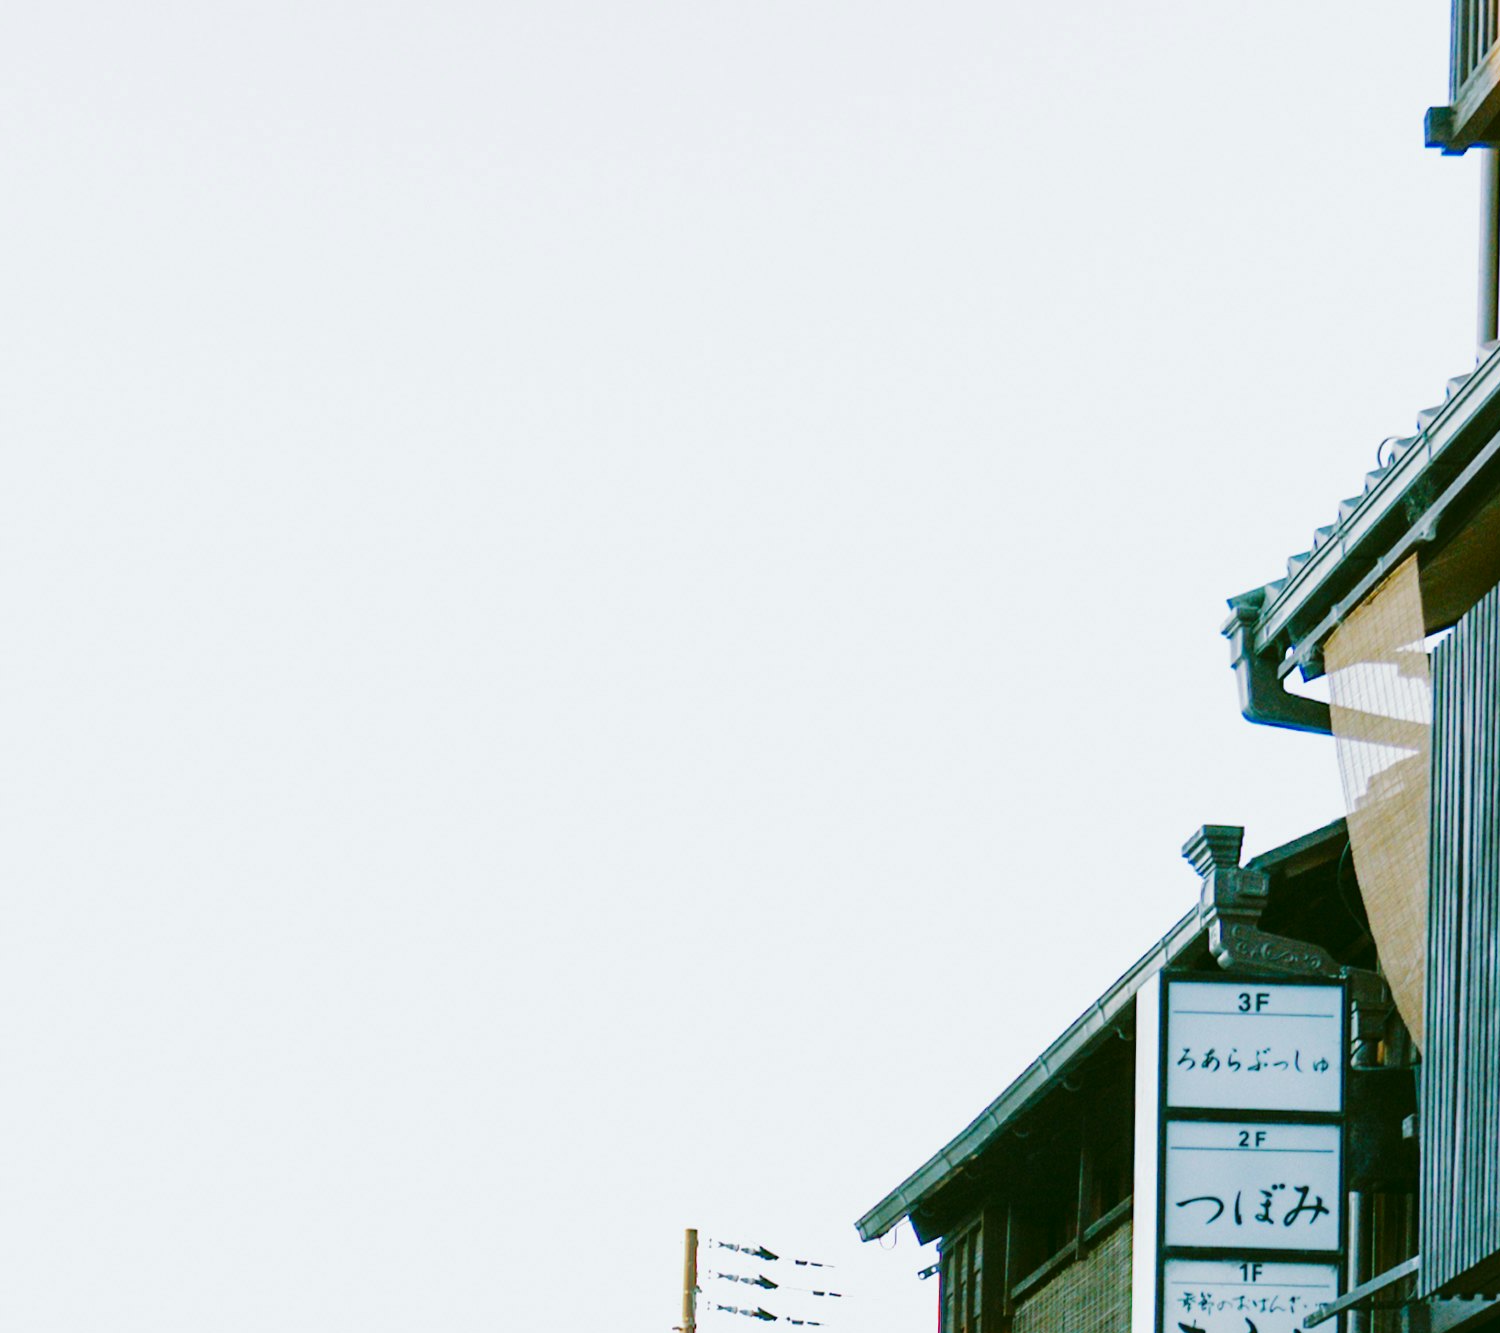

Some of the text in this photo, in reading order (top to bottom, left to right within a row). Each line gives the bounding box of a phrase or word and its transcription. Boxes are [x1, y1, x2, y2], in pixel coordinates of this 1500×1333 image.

[1238, 992, 1270, 1012] 3F
[1238, 1130, 1267, 1148] 2F
[1176, 1183, 1330, 1227] つぼみ
[1239, 1263, 1263, 1282] 1F
